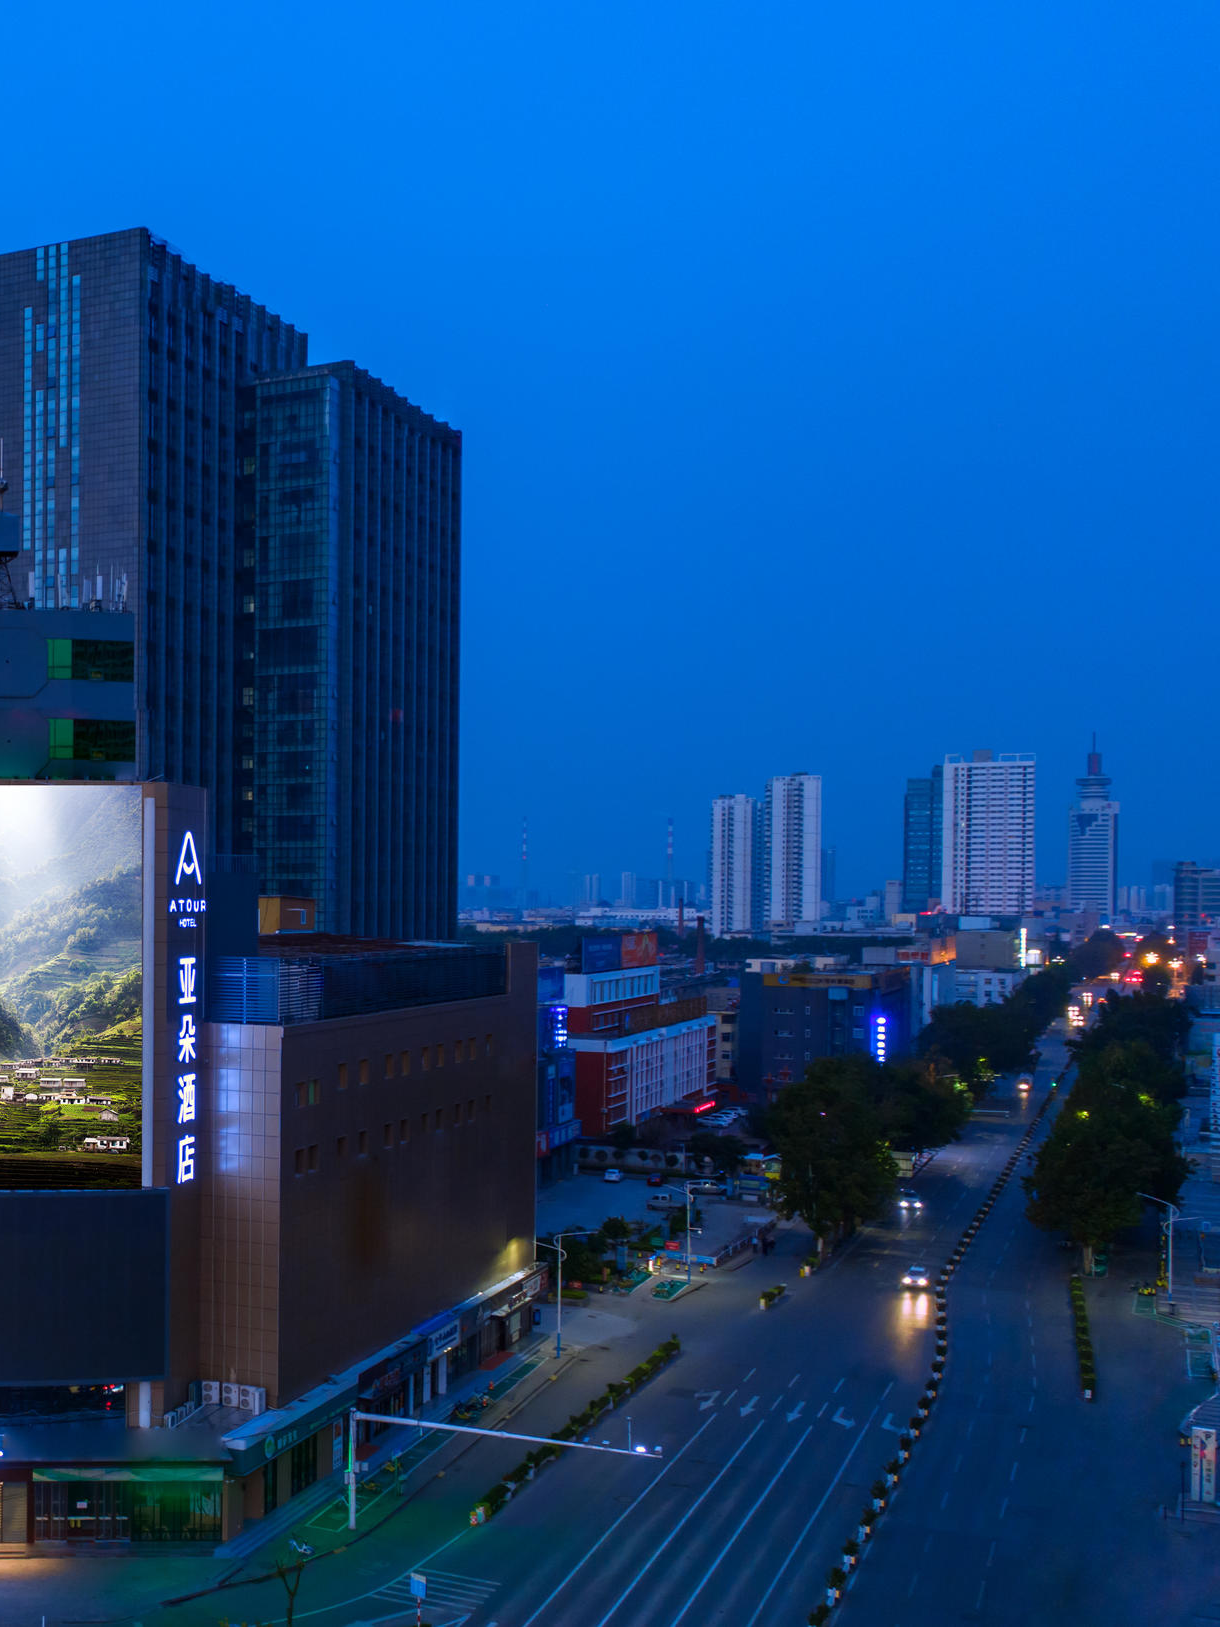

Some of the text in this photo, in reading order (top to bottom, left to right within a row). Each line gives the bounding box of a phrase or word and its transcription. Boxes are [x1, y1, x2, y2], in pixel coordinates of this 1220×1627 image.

[169, 899, 207, 913] ATOUR
[179, 918, 197, 928] HOTEL
[177, 957, 197, 1184] 亚朵酒店
